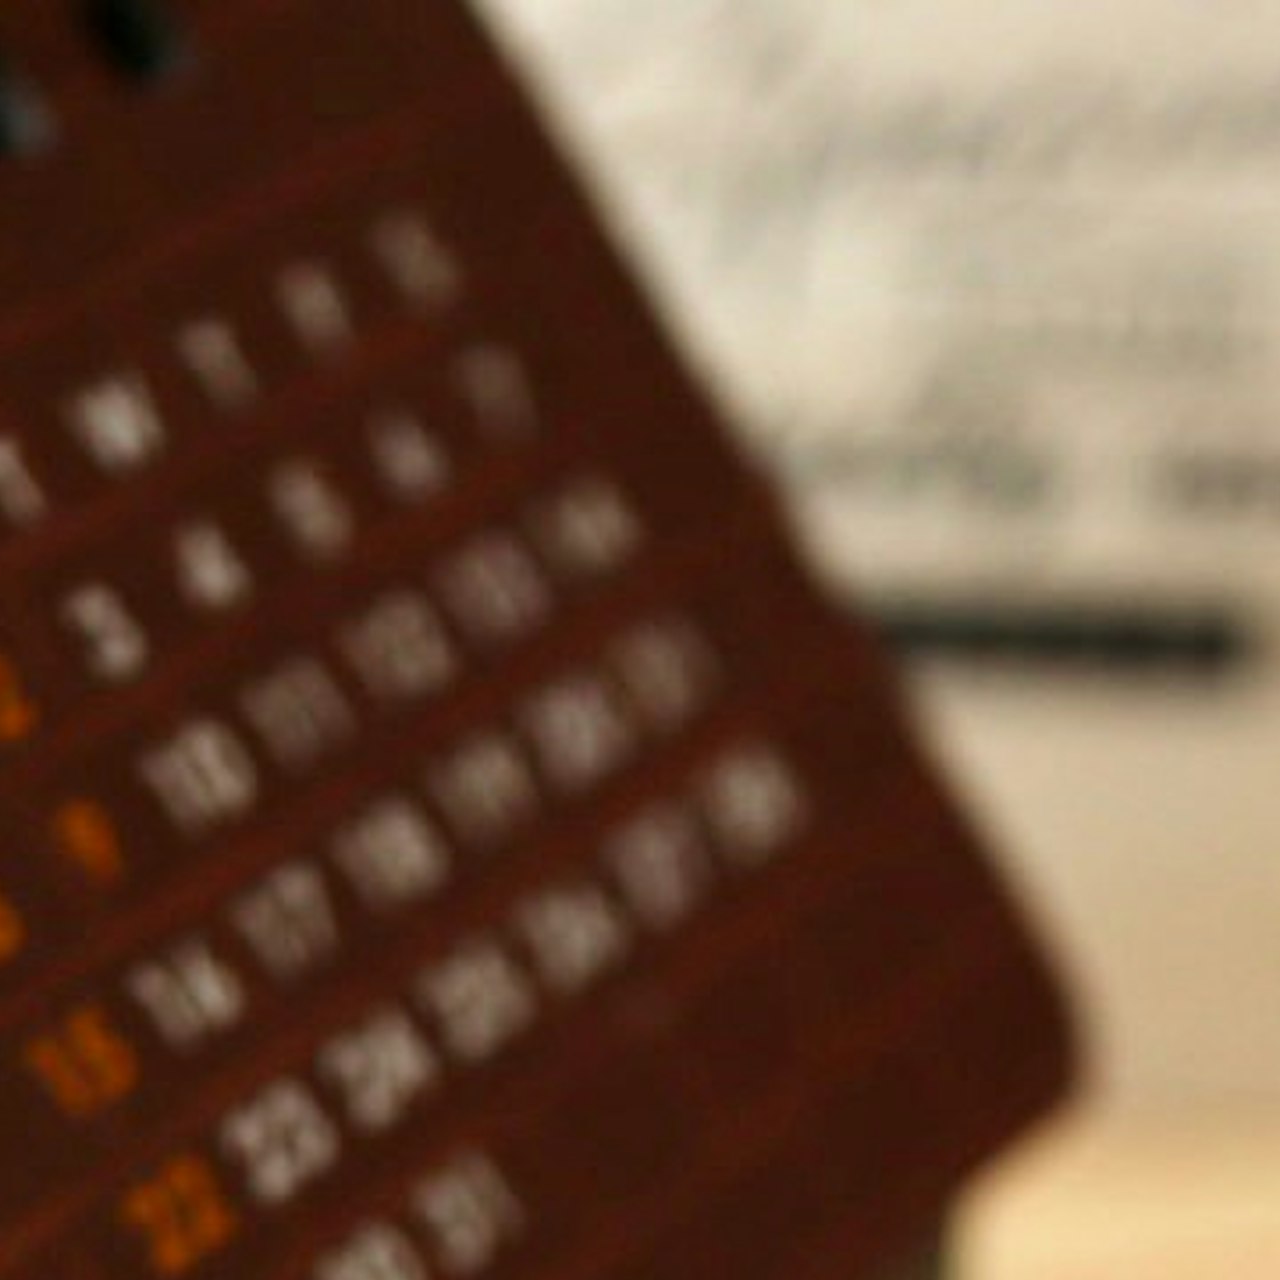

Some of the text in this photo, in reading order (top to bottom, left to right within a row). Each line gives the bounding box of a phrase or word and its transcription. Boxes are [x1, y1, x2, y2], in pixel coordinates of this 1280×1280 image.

[78, 381, 161, 464] W
[177, 319, 257, 402] T
[69, 587, 144, 676] 3
[147, 721, 256, 820] 10
[224, 1083, 336, 1200] 23
